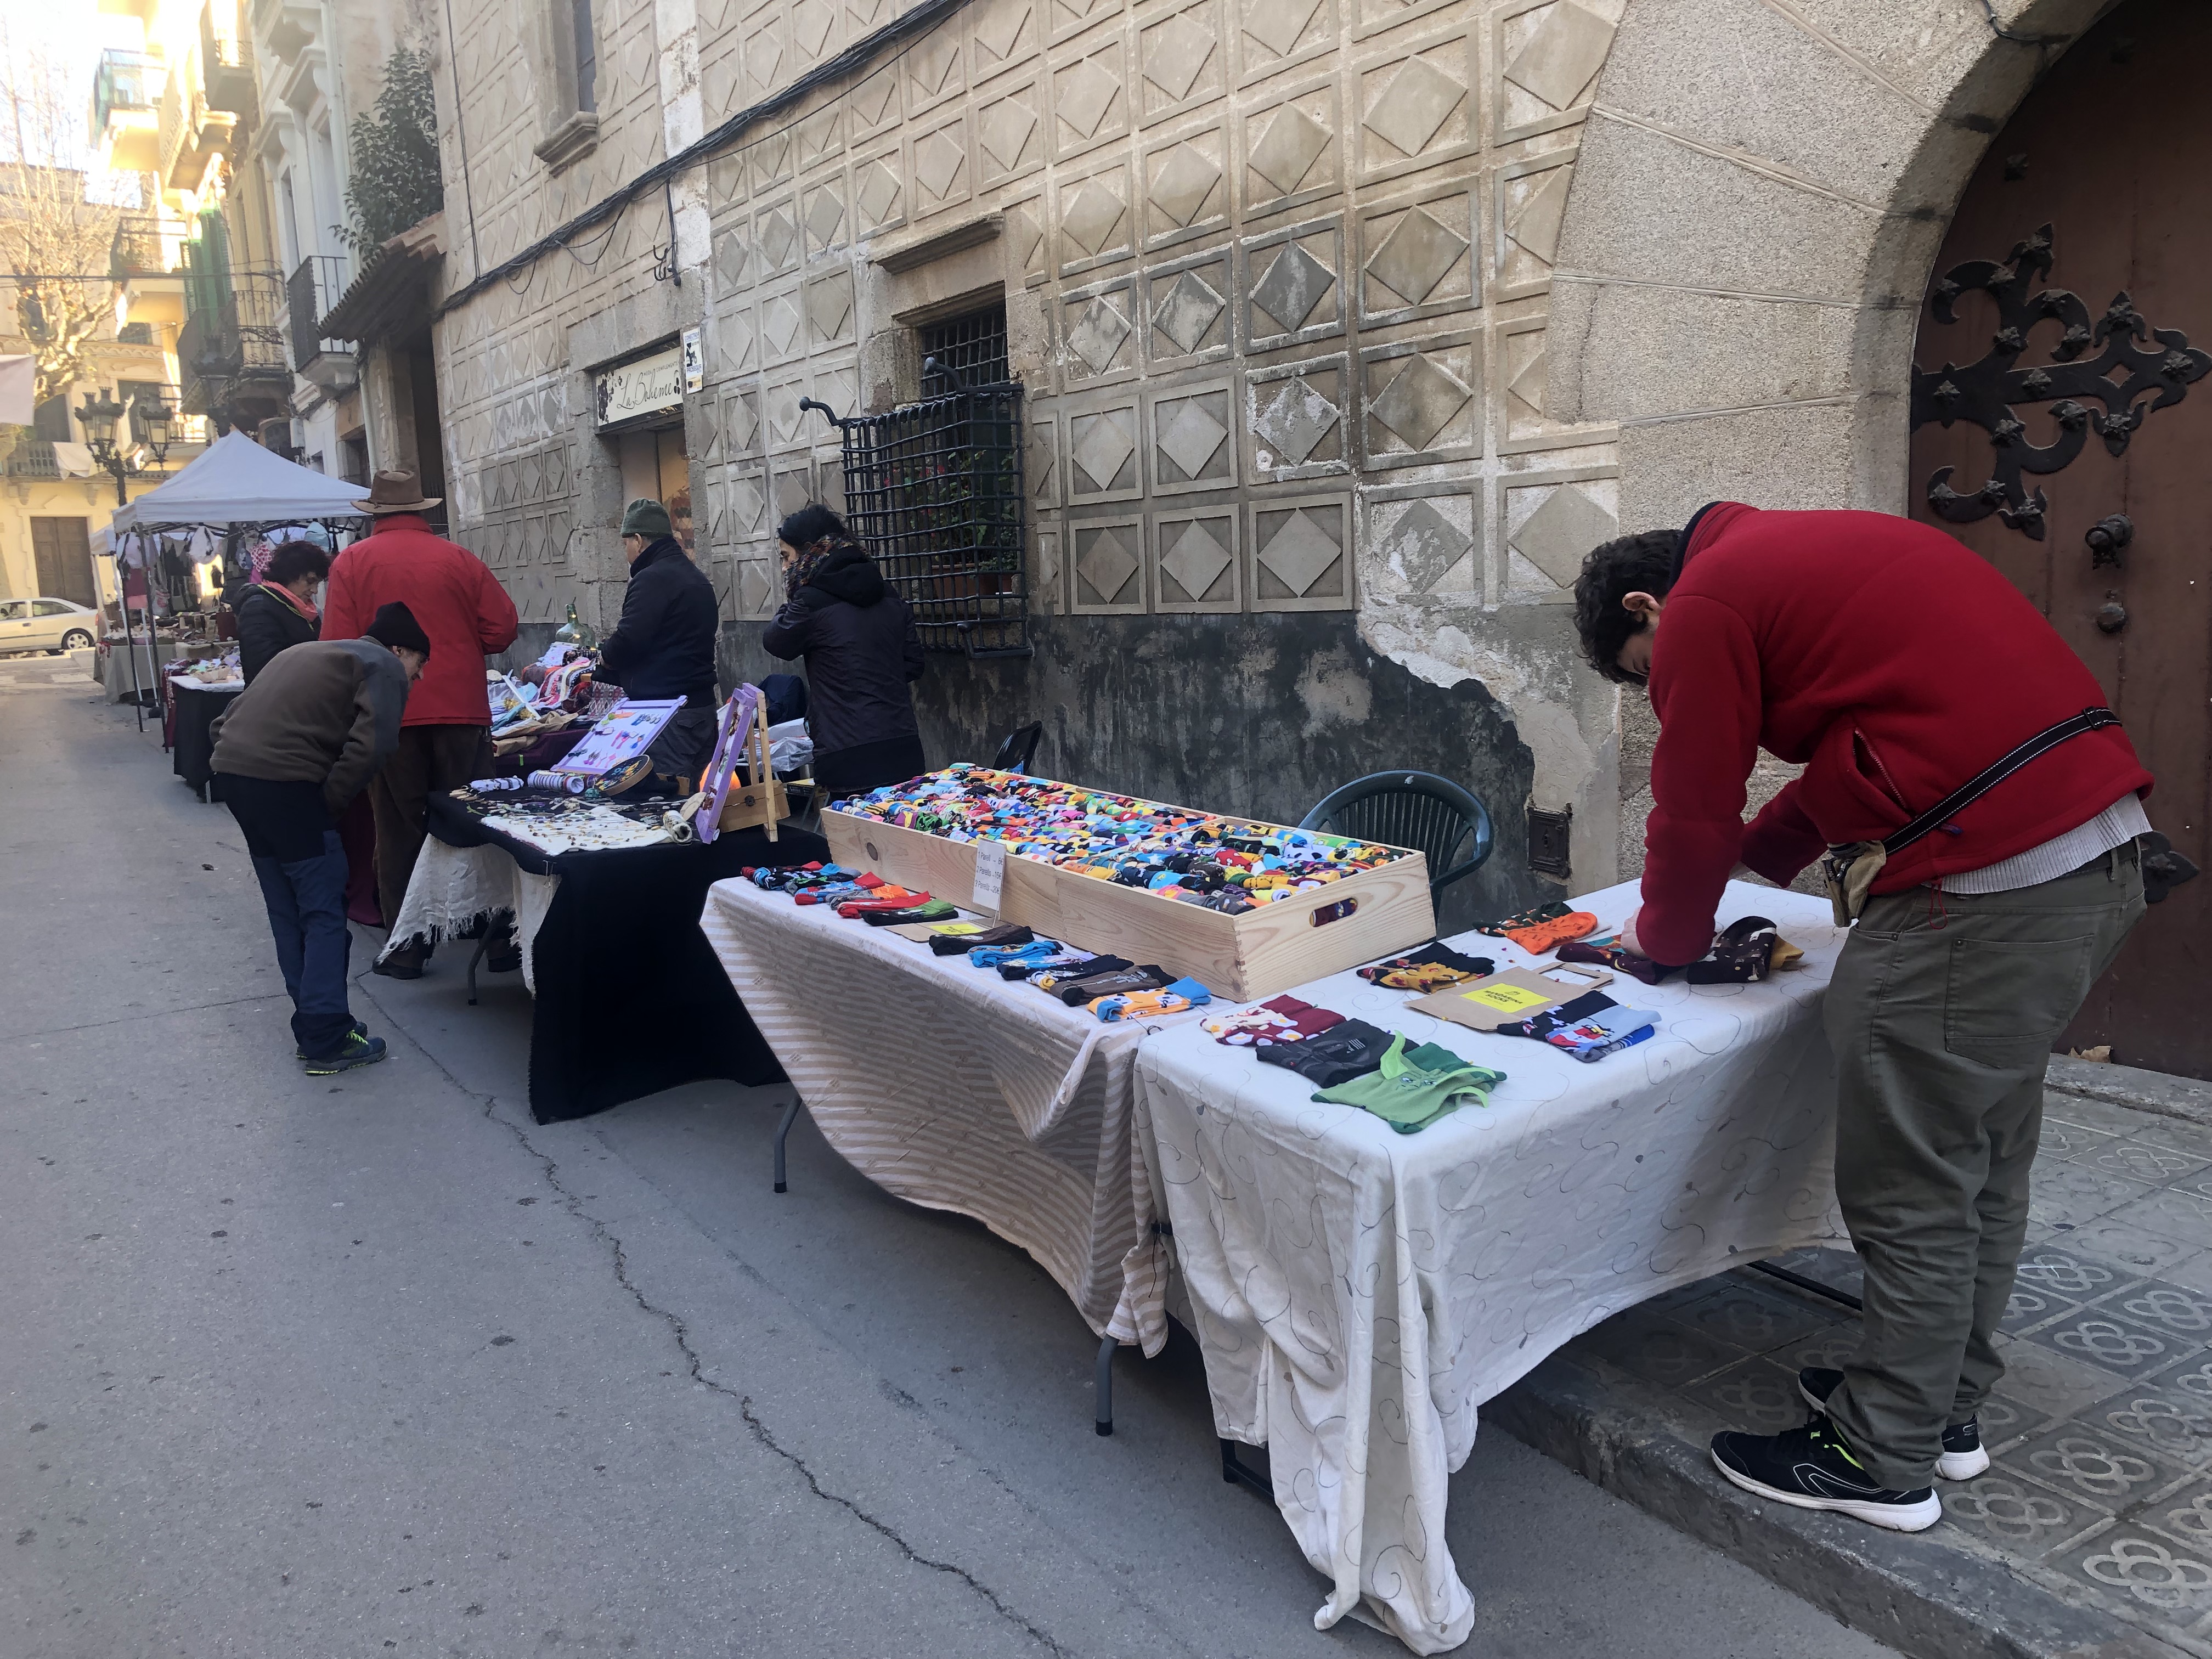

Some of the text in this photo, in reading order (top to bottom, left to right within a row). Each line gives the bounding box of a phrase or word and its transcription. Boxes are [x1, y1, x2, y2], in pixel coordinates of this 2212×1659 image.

[617, 373, 635, 410] La
[980, 852, 991, 862] Parell
[979, 866, 991, 877] Parells
[978, 881, 990, 891] Parells
[1483, 990, 1523, 1004] MANDARINA
[1486, 994, 1509, 1002] SOCKS
